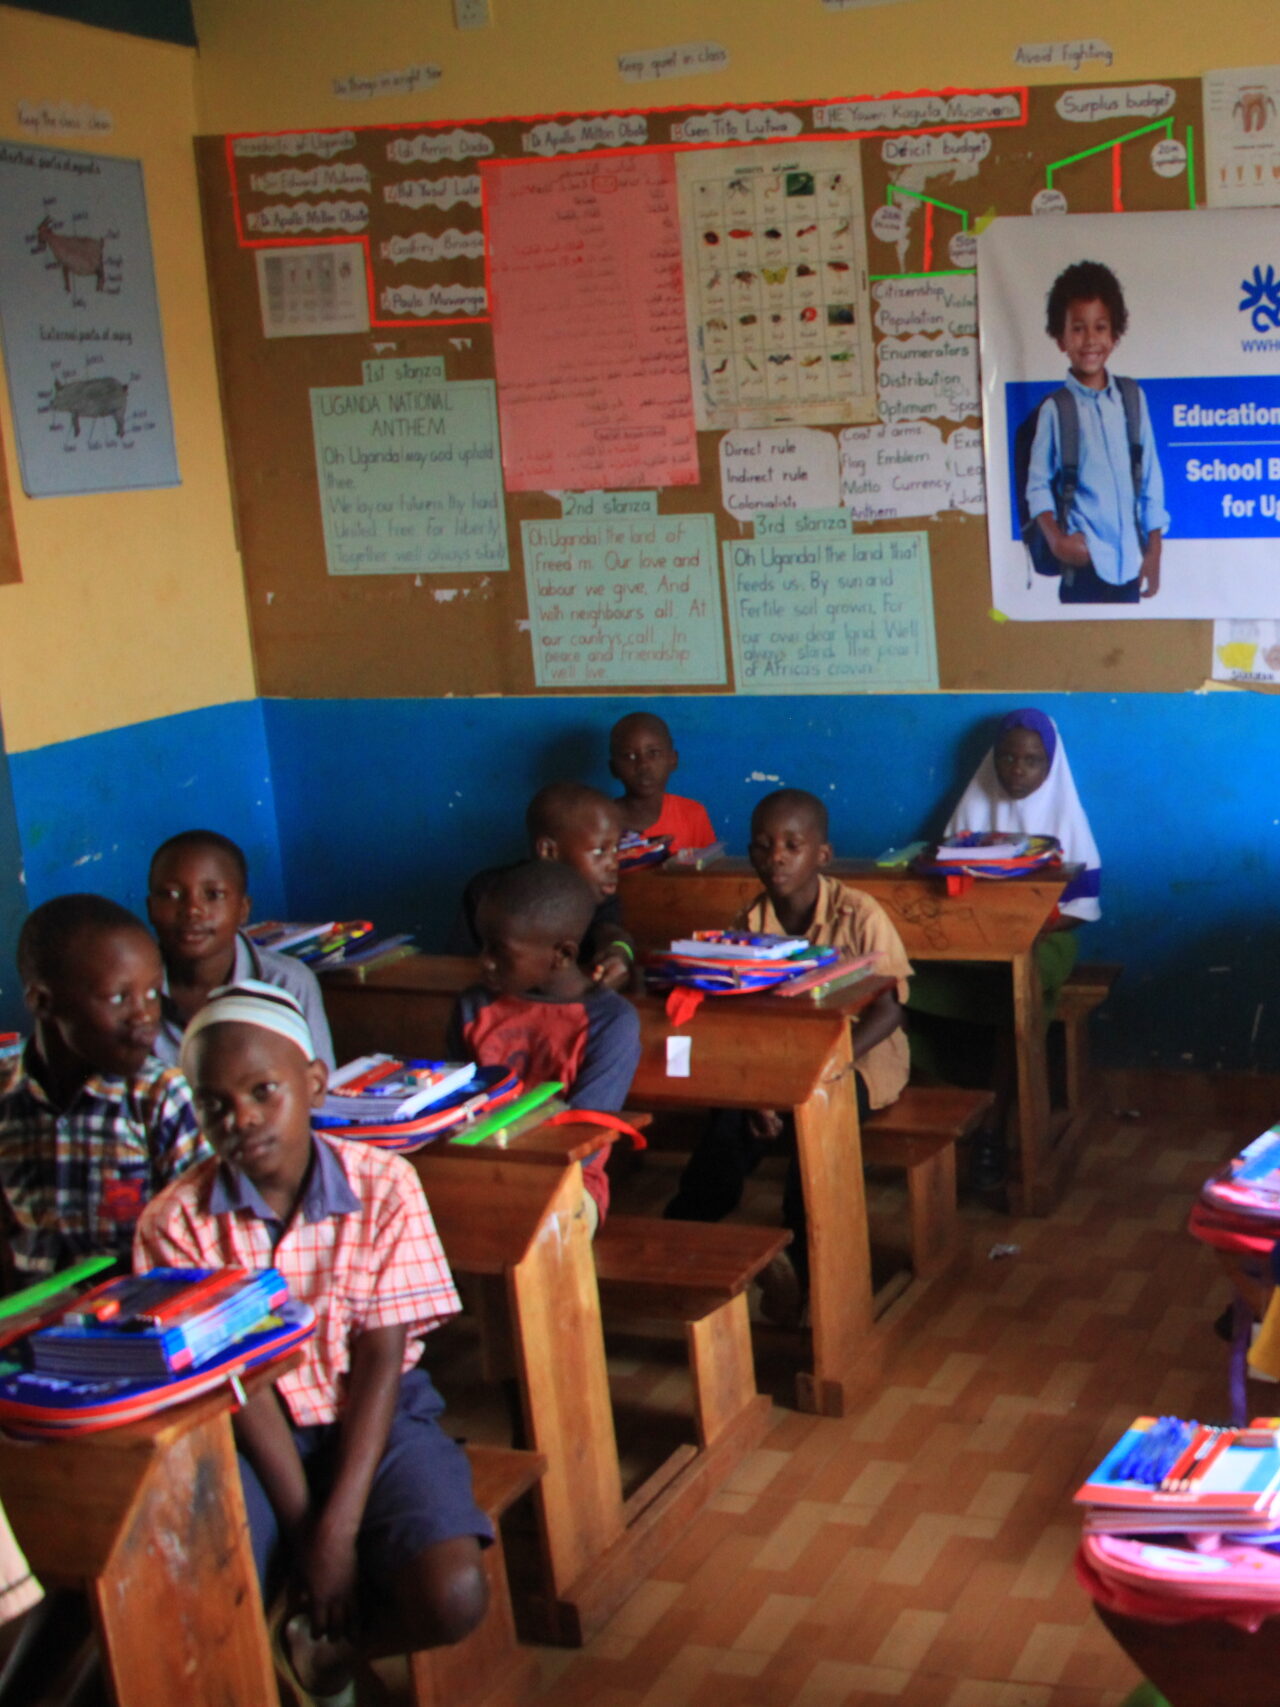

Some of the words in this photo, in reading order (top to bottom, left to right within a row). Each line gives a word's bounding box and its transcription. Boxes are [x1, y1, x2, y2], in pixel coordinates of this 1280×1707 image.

[1016, 46, 1052, 63] Avoid
[1063, 93, 1119, 119] Surplus
[1126, 89, 1170, 117] budget
[684, 121, 709, 138] Gen
[713, 118, 739, 136] Tito
[886, 139, 932, 159] Deficit
[943, 136, 987, 162] budget
[393, 293, 423, 310] Paulo
[874, 283, 945, 304] Citizenship
[880, 310, 944, 332] Population
[880, 343, 971, 362] Enumerators
[366, 362, 384, 383] 1st
[395, 362, 443, 382] stanza
[880, 369, 961, 389] Distribution
[320, 393, 381, 416] UGANDA
[388, 391, 454, 413] NATIONAL
[880, 401, 938, 423] Optimum
[372, 417, 447, 437] ANTHEM
[324, 445, 345, 465] Oh
[725, 440, 761, 457] Direct
[770, 437, 797, 455] rule
[727, 461, 774, 483] Indirect
[783, 460, 808, 481] rule
[842, 452, 867, 476] Flag
[877, 449, 930, 466] Emblem
[1186, 459, 1262, 482] School
[842, 480, 881, 497] Motto
[891, 475, 952, 497] Currency
[564, 494, 595, 516] 2nd
[603, 496, 651, 515] stanza
[850, 503, 897, 519] Anthem
[1222, 494, 1256, 519] for
[528, 527, 547, 547] Oh
[606, 524, 625, 544] the
[629, 522, 656, 545] land
[666, 521, 686, 544] of
[756, 516, 785, 535] 3rd
[796, 514, 848, 533] stanza
[605, 550, 631, 571] Our
[640, 547, 667, 569] love
[673, 547, 701, 569] and
[735, 547, 756, 567] Oh
[825, 545, 847, 563] the
[852, 542, 883, 561] land
[891, 541, 918, 559] that
[538, 577, 577, 597] labour
[586, 584, 606, 596] we
[657, 573, 690, 594] And
[810, 569, 829, 596] By
[838, 575, 863, 589] sun
[865, 568, 894, 587] and
[540, 603, 564, 621] with
[570, 600, 645, 629] neighbours
[654, 598, 674, 619] all
[688, 597, 707, 617] At
[740, 598, 784, 618] Fertile
[794, 599, 817, 616] soil
[884, 592, 904, 613] For
[542, 634, 562, 647] our
[672, 624, 688, 644] In
[742, 631, 761, 646] our
[545, 650, 580, 670] peace
[587, 643, 614, 662] and
[585, 662, 607, 679] live
[745, 663, 758, 678] of
[827, 662, 873, 676] crown
